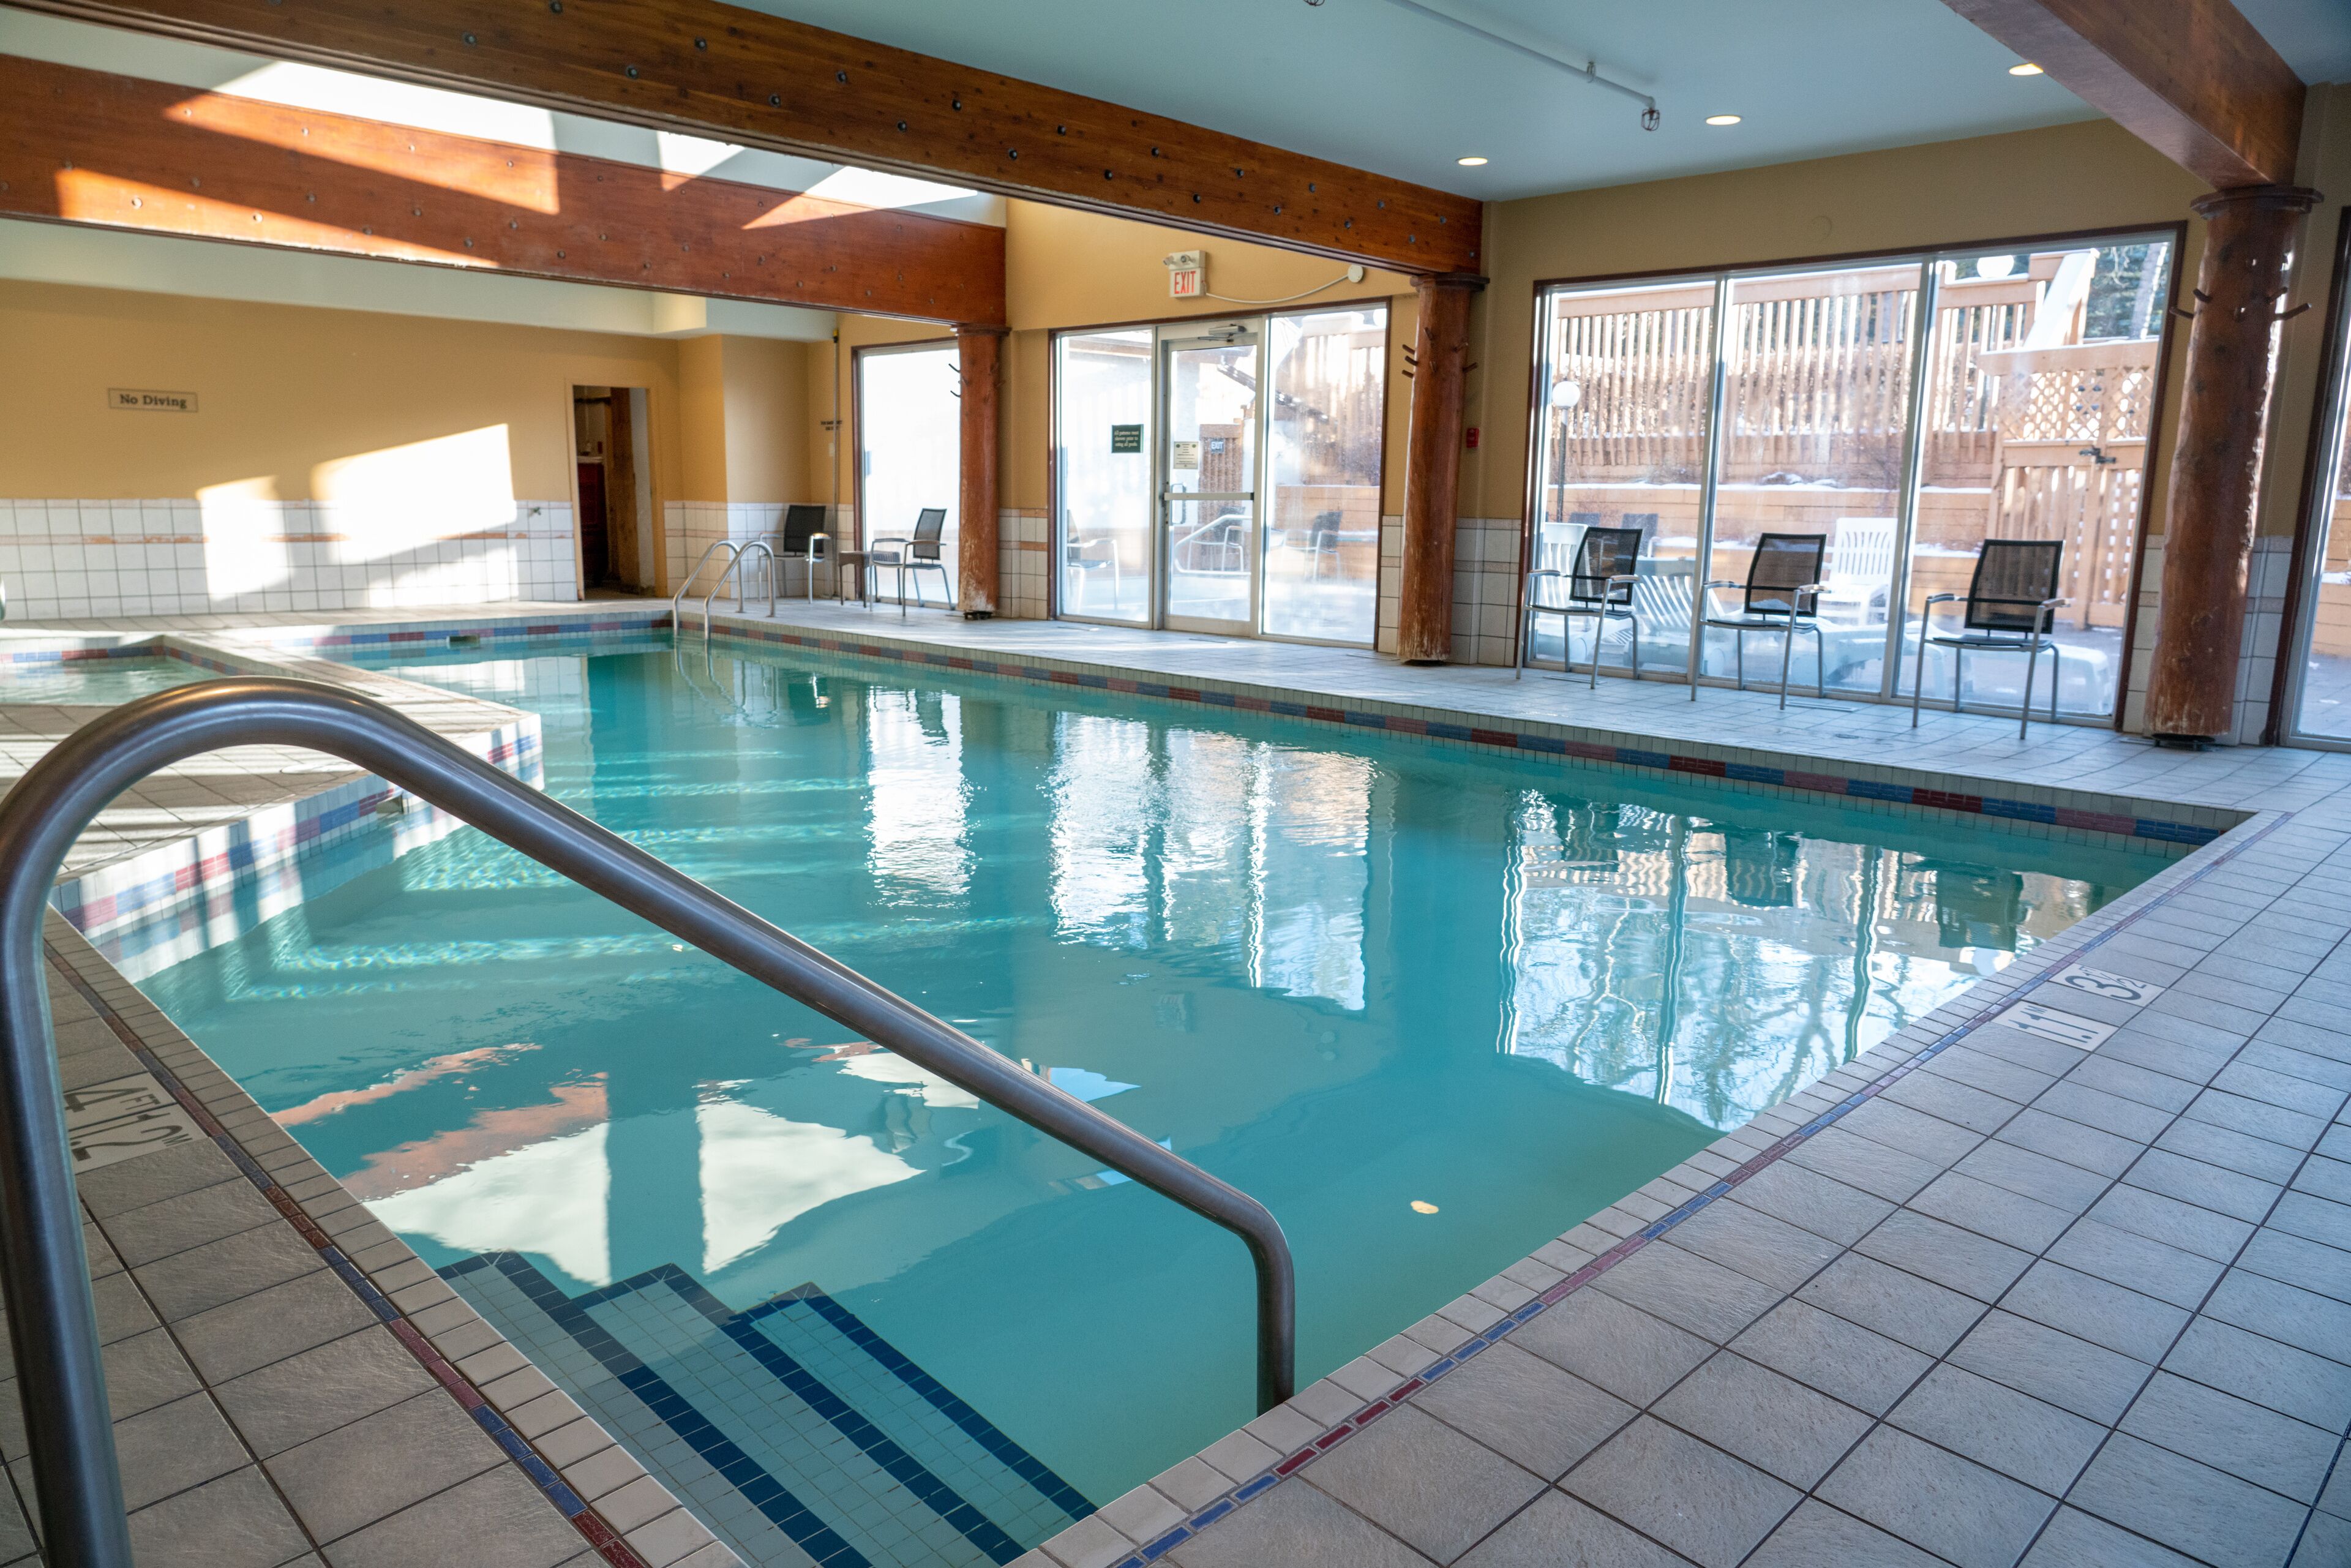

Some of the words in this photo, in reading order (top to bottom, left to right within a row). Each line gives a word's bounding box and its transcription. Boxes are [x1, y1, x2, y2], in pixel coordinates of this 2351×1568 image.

[1174, 271, 1196, 294] EXIT
[119, 394, 138, 405] No
[143, 395, 187, 409] Diving
[2008, 1011, 2099, 1043] 1.1
[64, 1087, 148, 1113] 4
[120, 1093, 161, 1111] FT
[69, 1112, 182, 1161] 1.2
[162, 1133, 193, 1147] M
